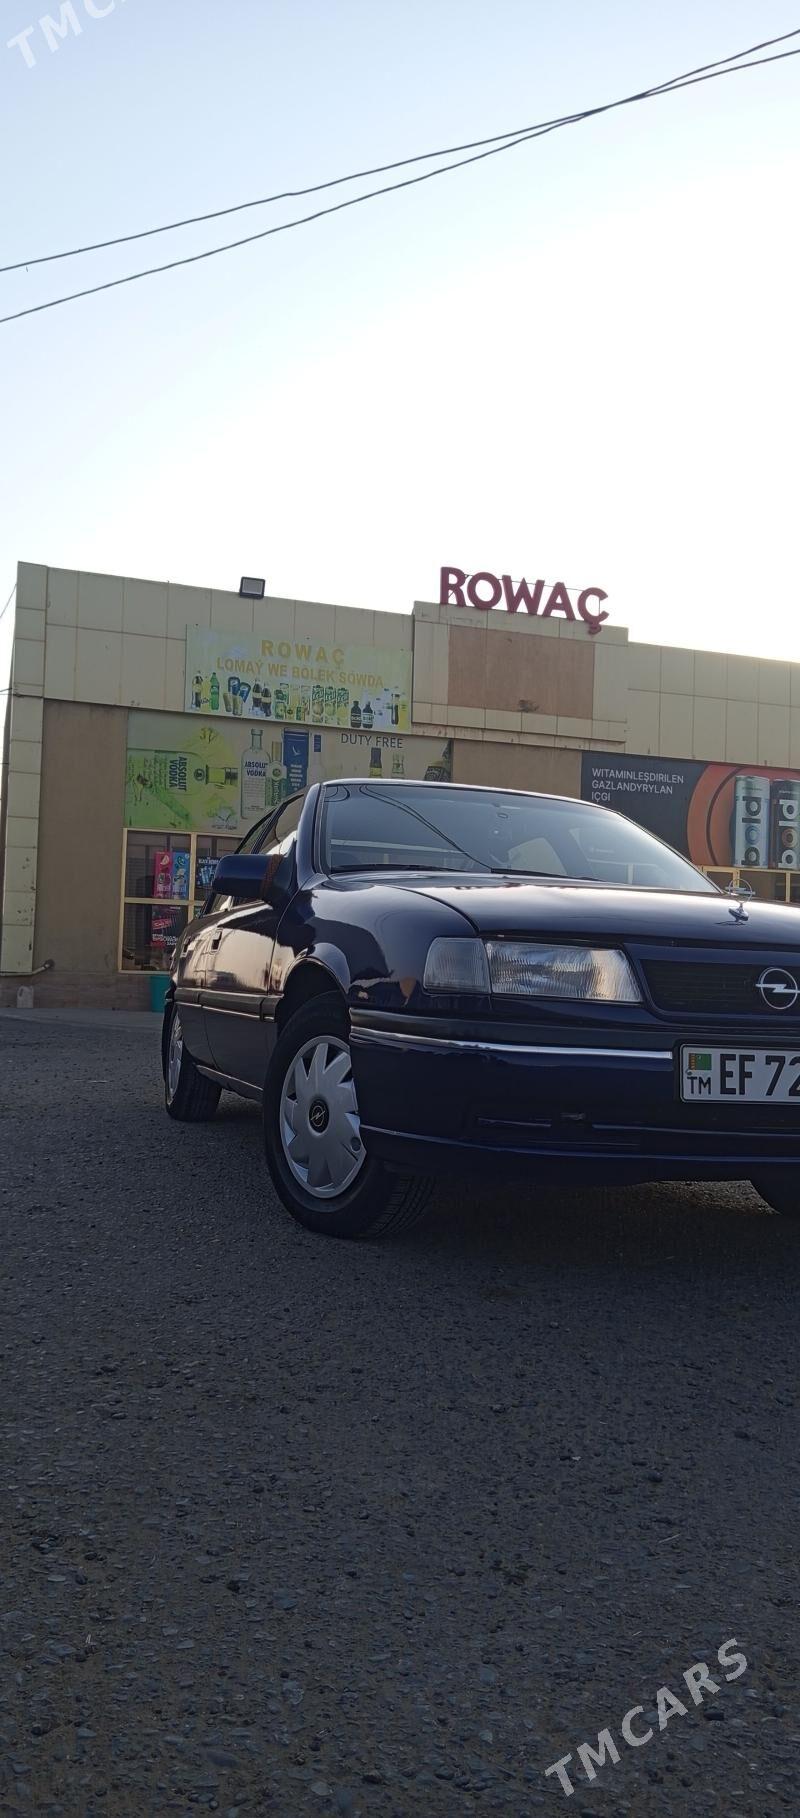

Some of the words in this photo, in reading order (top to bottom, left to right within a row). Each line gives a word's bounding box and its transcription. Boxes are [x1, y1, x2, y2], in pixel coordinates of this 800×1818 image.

[440, 566, 609, 636] ROWAÇ
[261, 639, 345, 669] ROWAÇ
[268, 663, 287, 677] WE
[341, 733, 372, 746] DUTY
[376, 736, 404, 749] FREE
[169, 760, 178, 788] VODKA
[178, 756, 187, 792] ABSOLUT
[592, 767, 684, 784] WITAMINLEŞDIRILEN
[592, 779, 673, 795] GAZLANDYRYLAN
[592, 791, 611, 802] IÇGI
[741, 796, 761, 866] bold
[778, 799, 800, 868] bold
[687, 1076, 712, 1095] TM
[720, 1053, 755, 1095] EF
